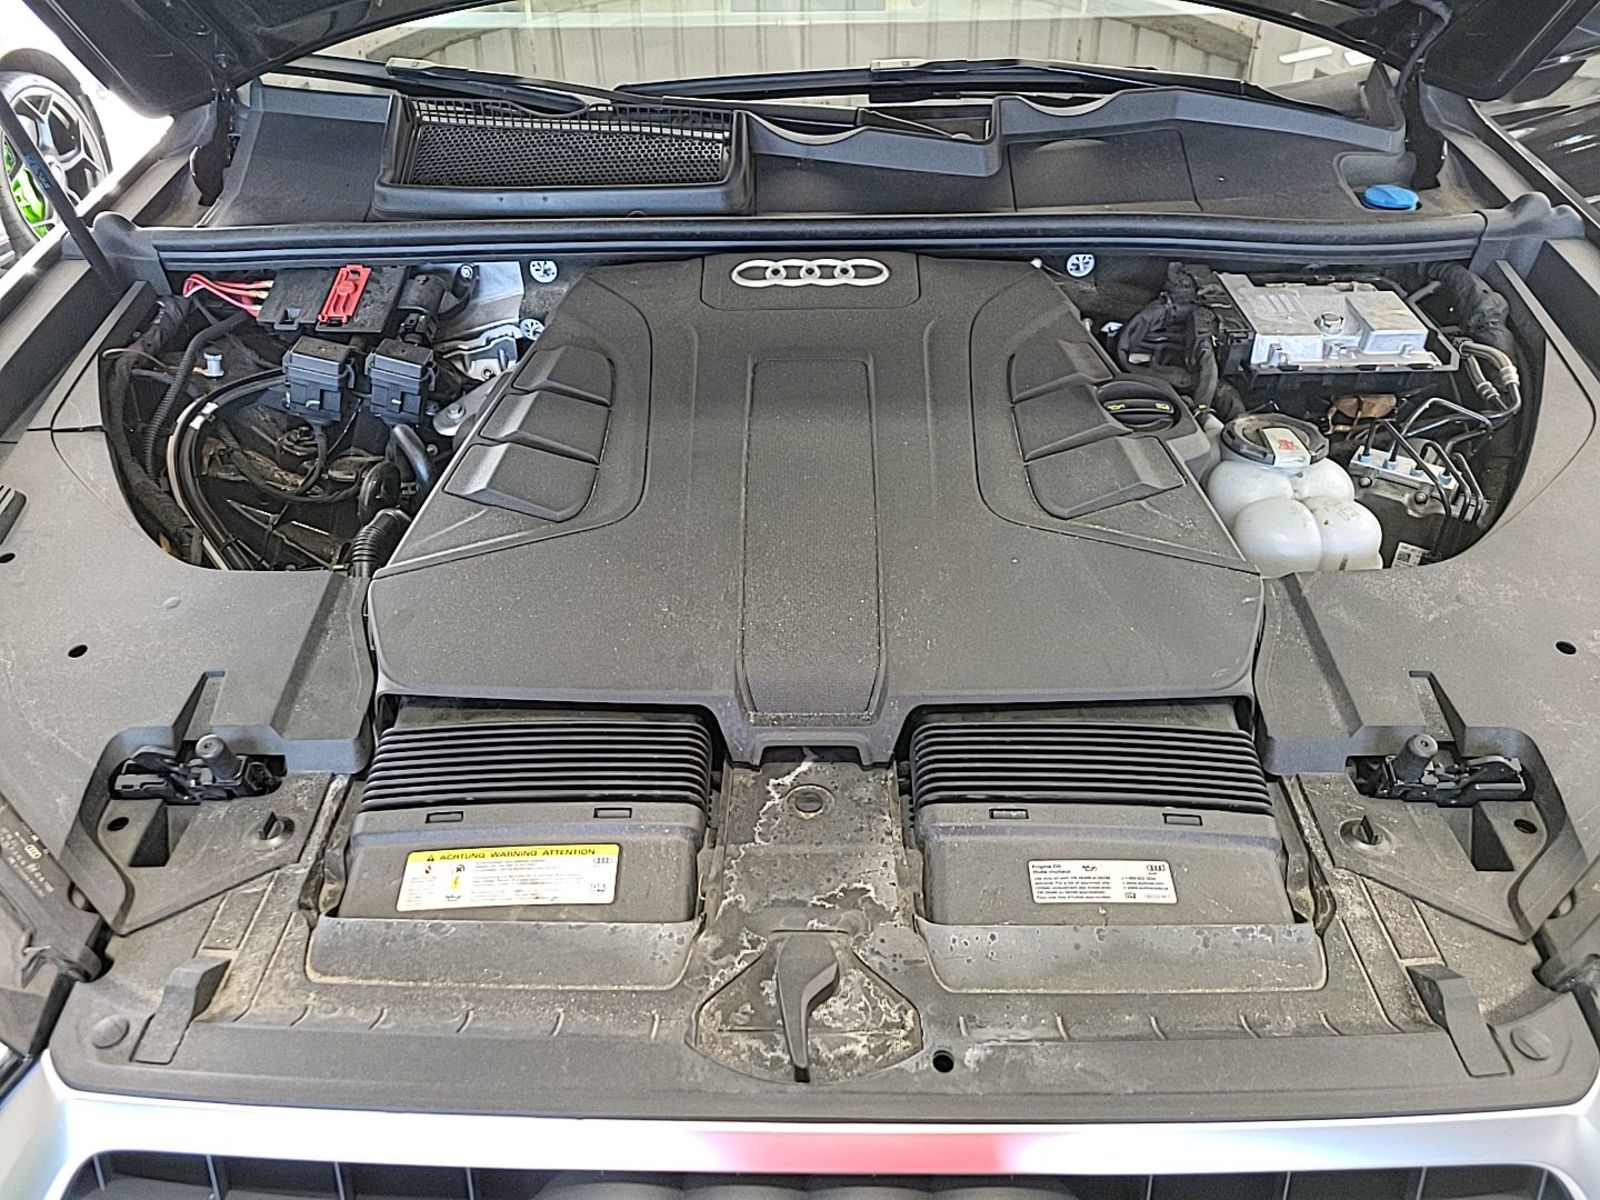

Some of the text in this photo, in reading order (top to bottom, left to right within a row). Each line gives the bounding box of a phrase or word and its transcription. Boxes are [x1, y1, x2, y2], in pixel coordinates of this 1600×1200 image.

[440, 848, 596, 861] ACHTUNG WARNING ATTENTION
